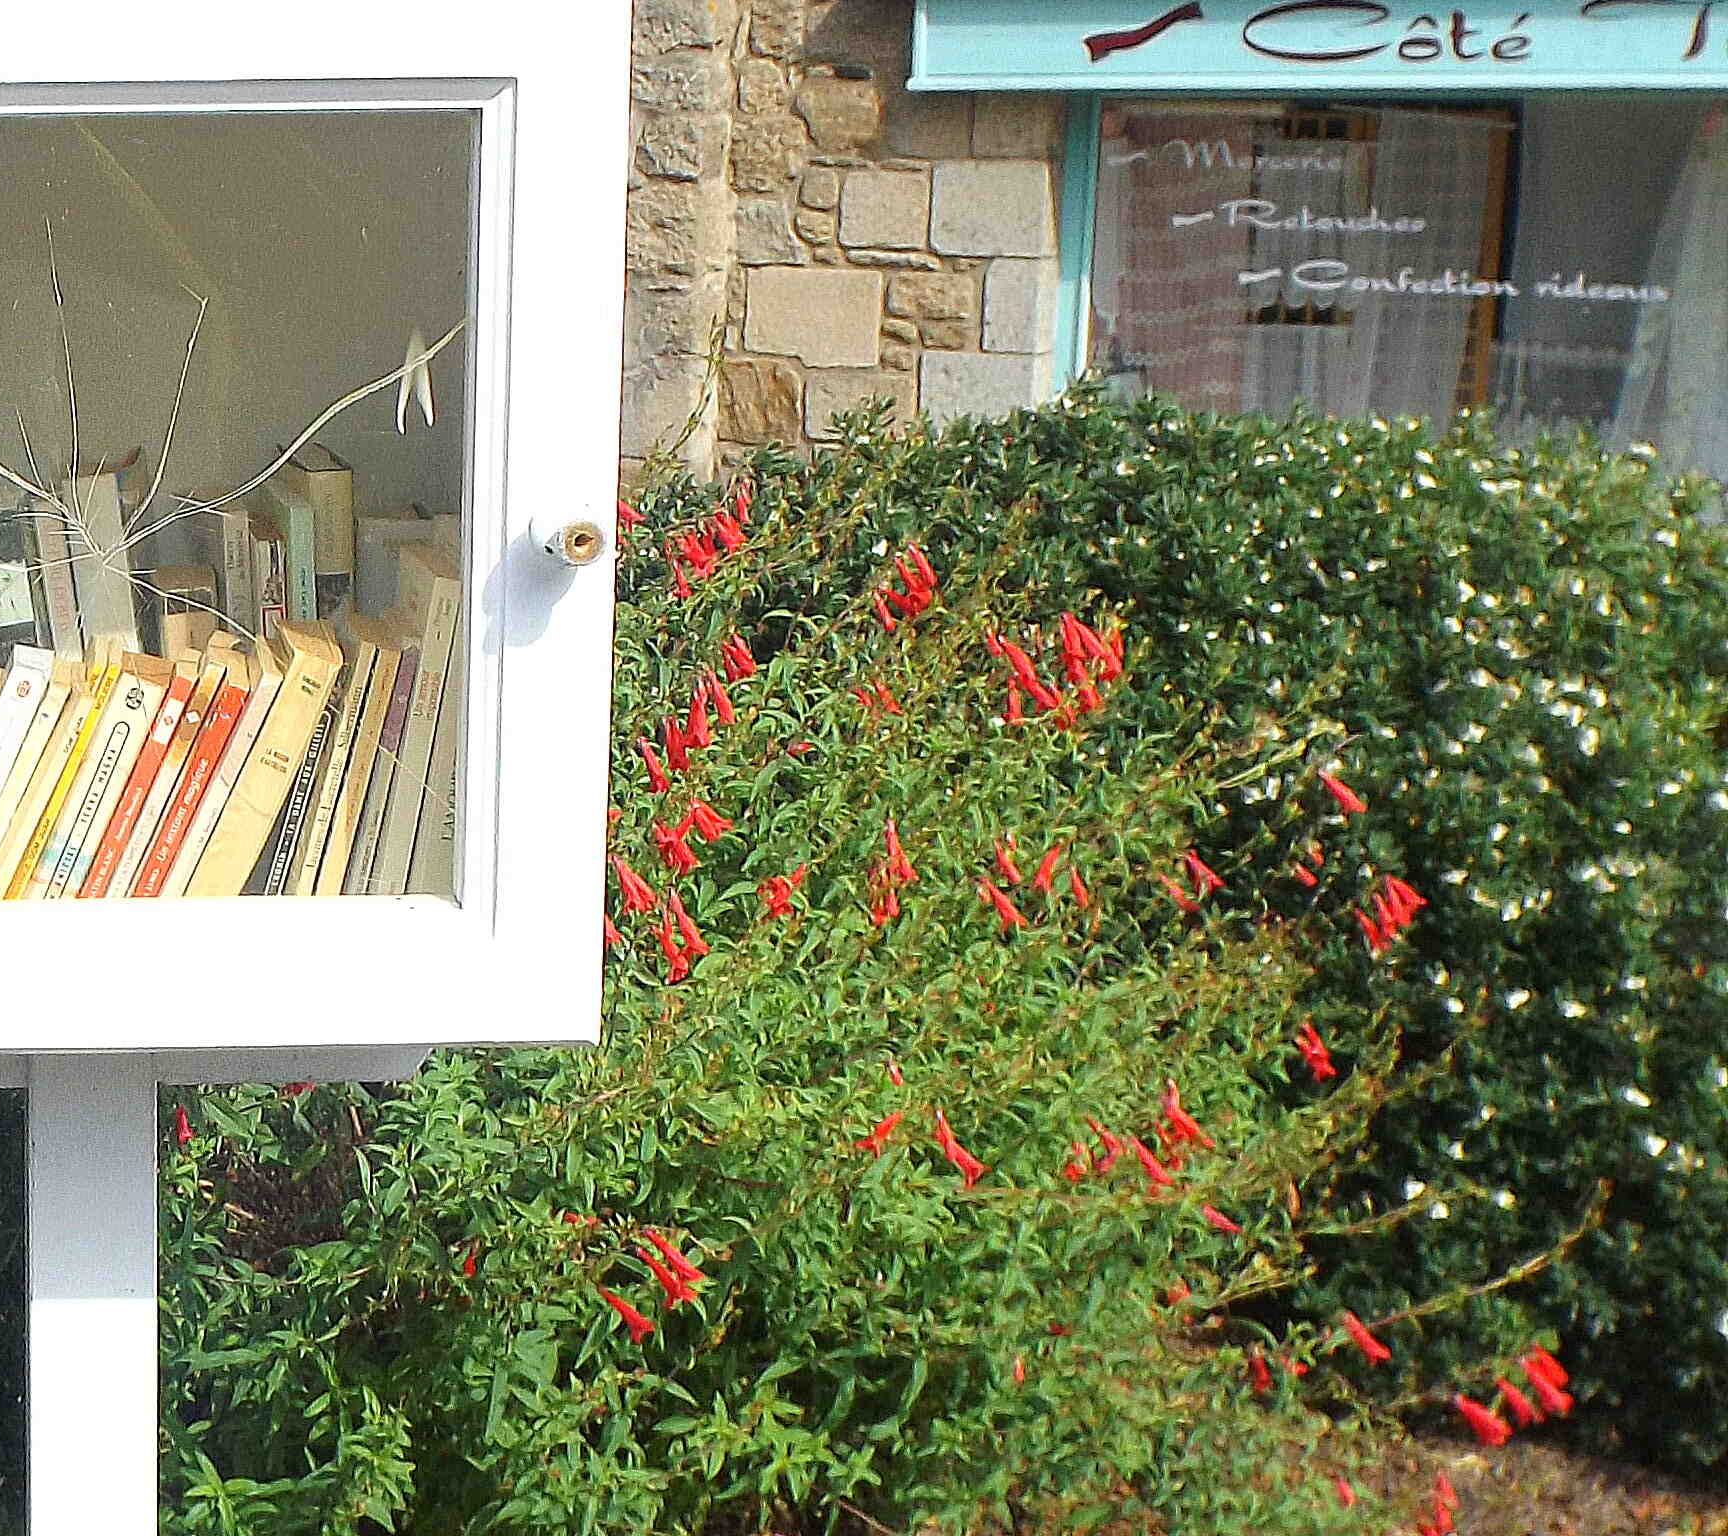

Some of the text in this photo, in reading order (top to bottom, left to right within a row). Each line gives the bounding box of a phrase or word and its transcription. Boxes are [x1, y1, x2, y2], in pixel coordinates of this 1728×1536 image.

[1218, 198, 1427, 235] Retouches
[1290, 258, 1520, 299] Confection
[183, 758, 210, 805] magique
